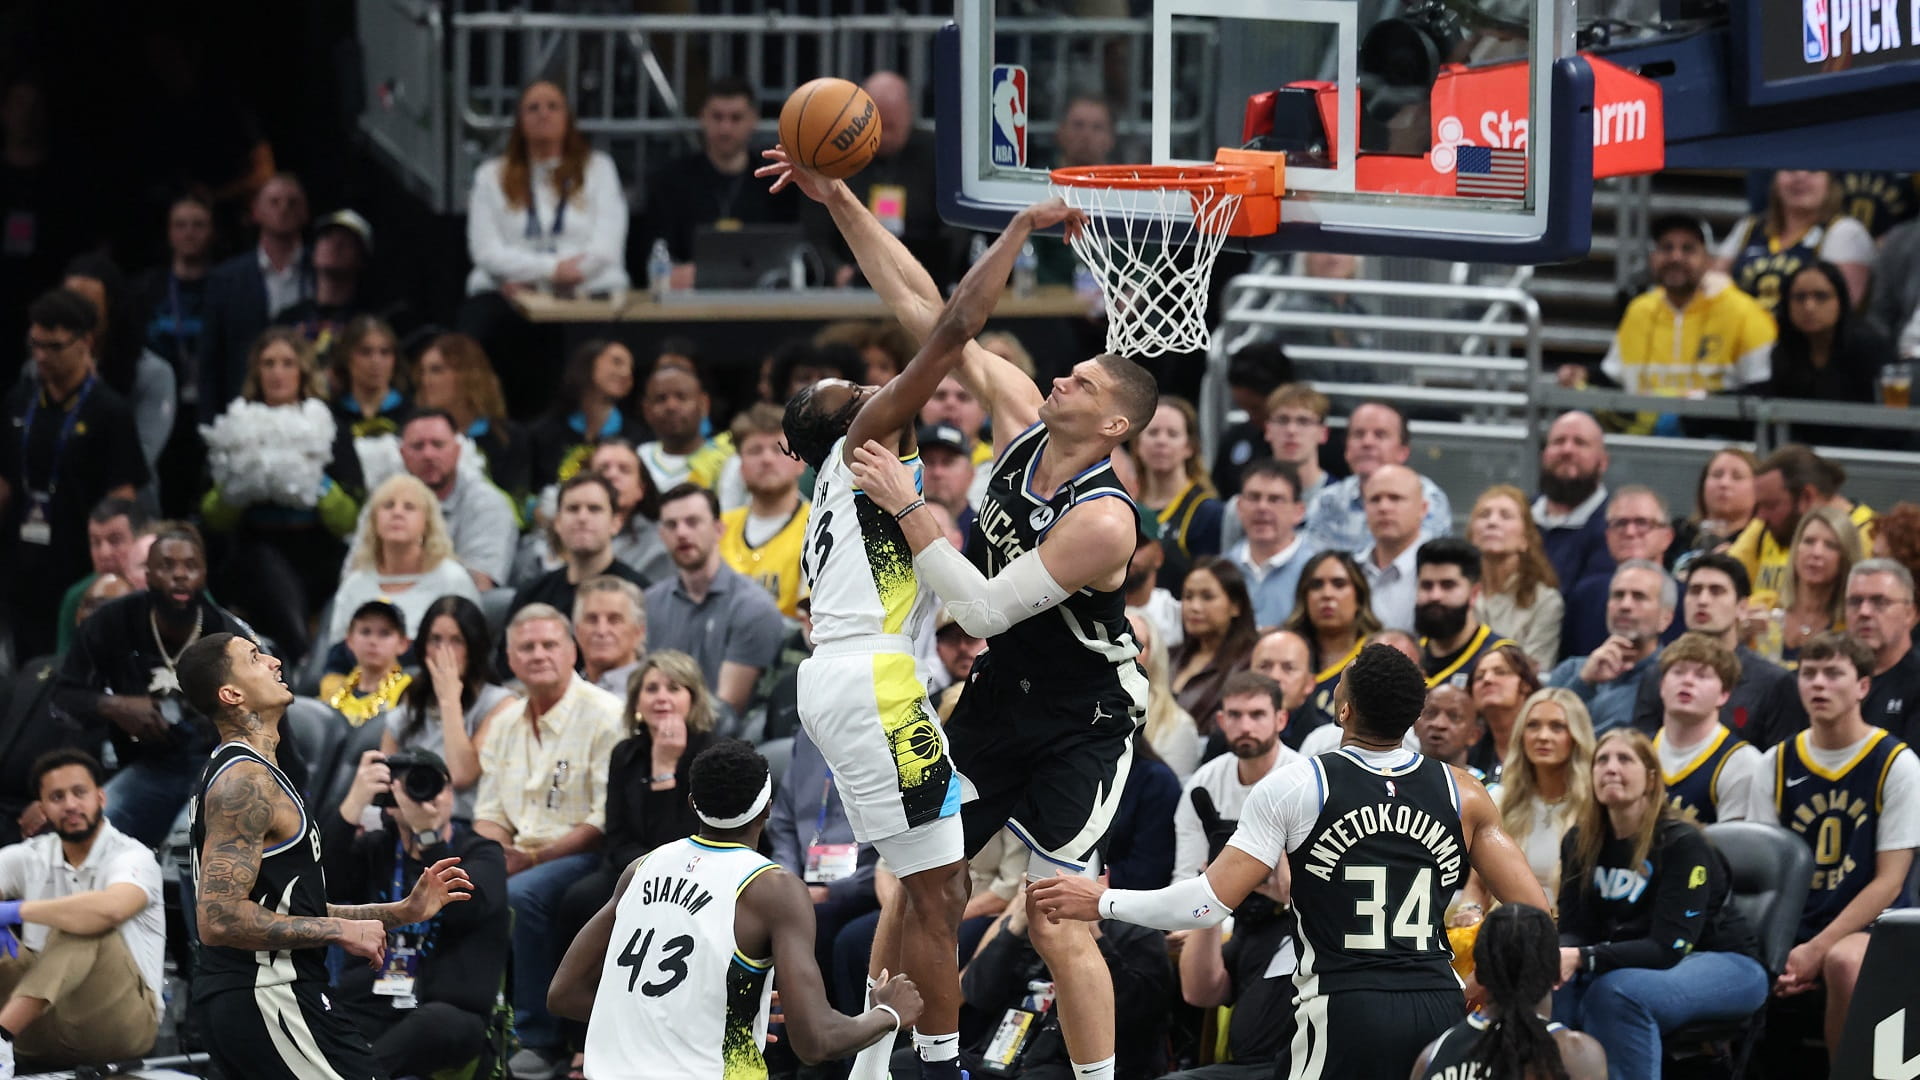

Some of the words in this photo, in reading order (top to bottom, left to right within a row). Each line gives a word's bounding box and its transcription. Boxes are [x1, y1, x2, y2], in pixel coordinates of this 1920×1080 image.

[1831, 0, 1901, 57] PICK
[830, 99, 874, 151] Wilson
[995, 145, 1013, 163] NBA
[1304, 803, 1461, 888] ANTETOKOUNMPO
[1815, 815, 1842, 866] 0
[643, 877, 713, 915] SIAKAM
[1593, 859, 1654, 904] NDY
[1344, 865, 1434, 951] 34
[617, 928, 695, 998] 43
